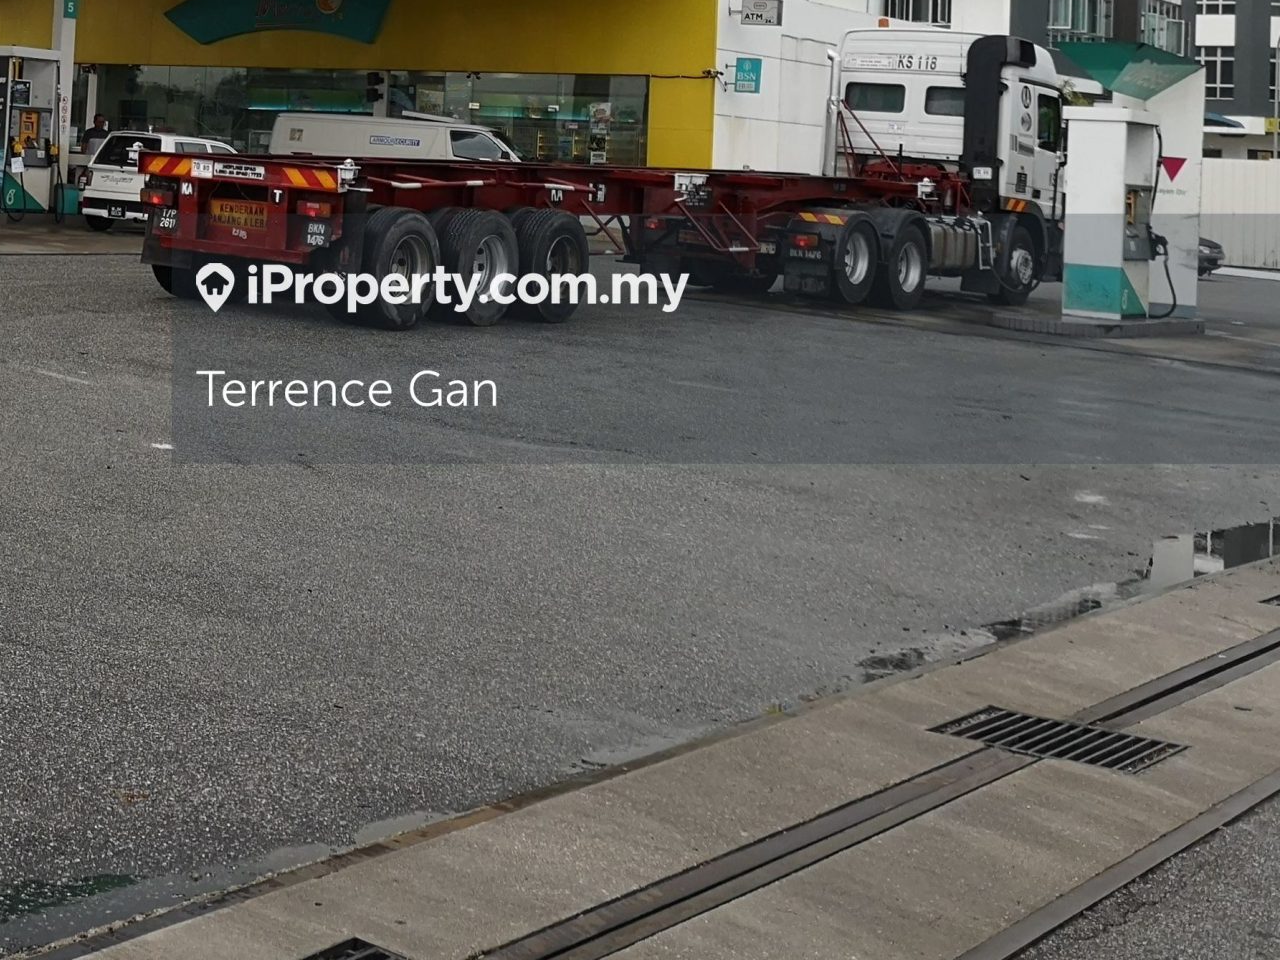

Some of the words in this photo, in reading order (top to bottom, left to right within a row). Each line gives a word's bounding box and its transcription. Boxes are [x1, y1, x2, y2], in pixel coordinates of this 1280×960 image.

[67, 2, 75, 13] 5
[744, 13, 763, 21] ATM
[898, 54, 913, 69] KS
[918, 56, 938, 70] 118
[737, 72, 756, 81] BSN
[181, 182, 193, 195] KA
[273, 189, 283, 203] T
[220, 203, 265, 216] KENDERAAN
[307, 223, 326, 234] BKN
[307, 234, 325, 246] 1476
